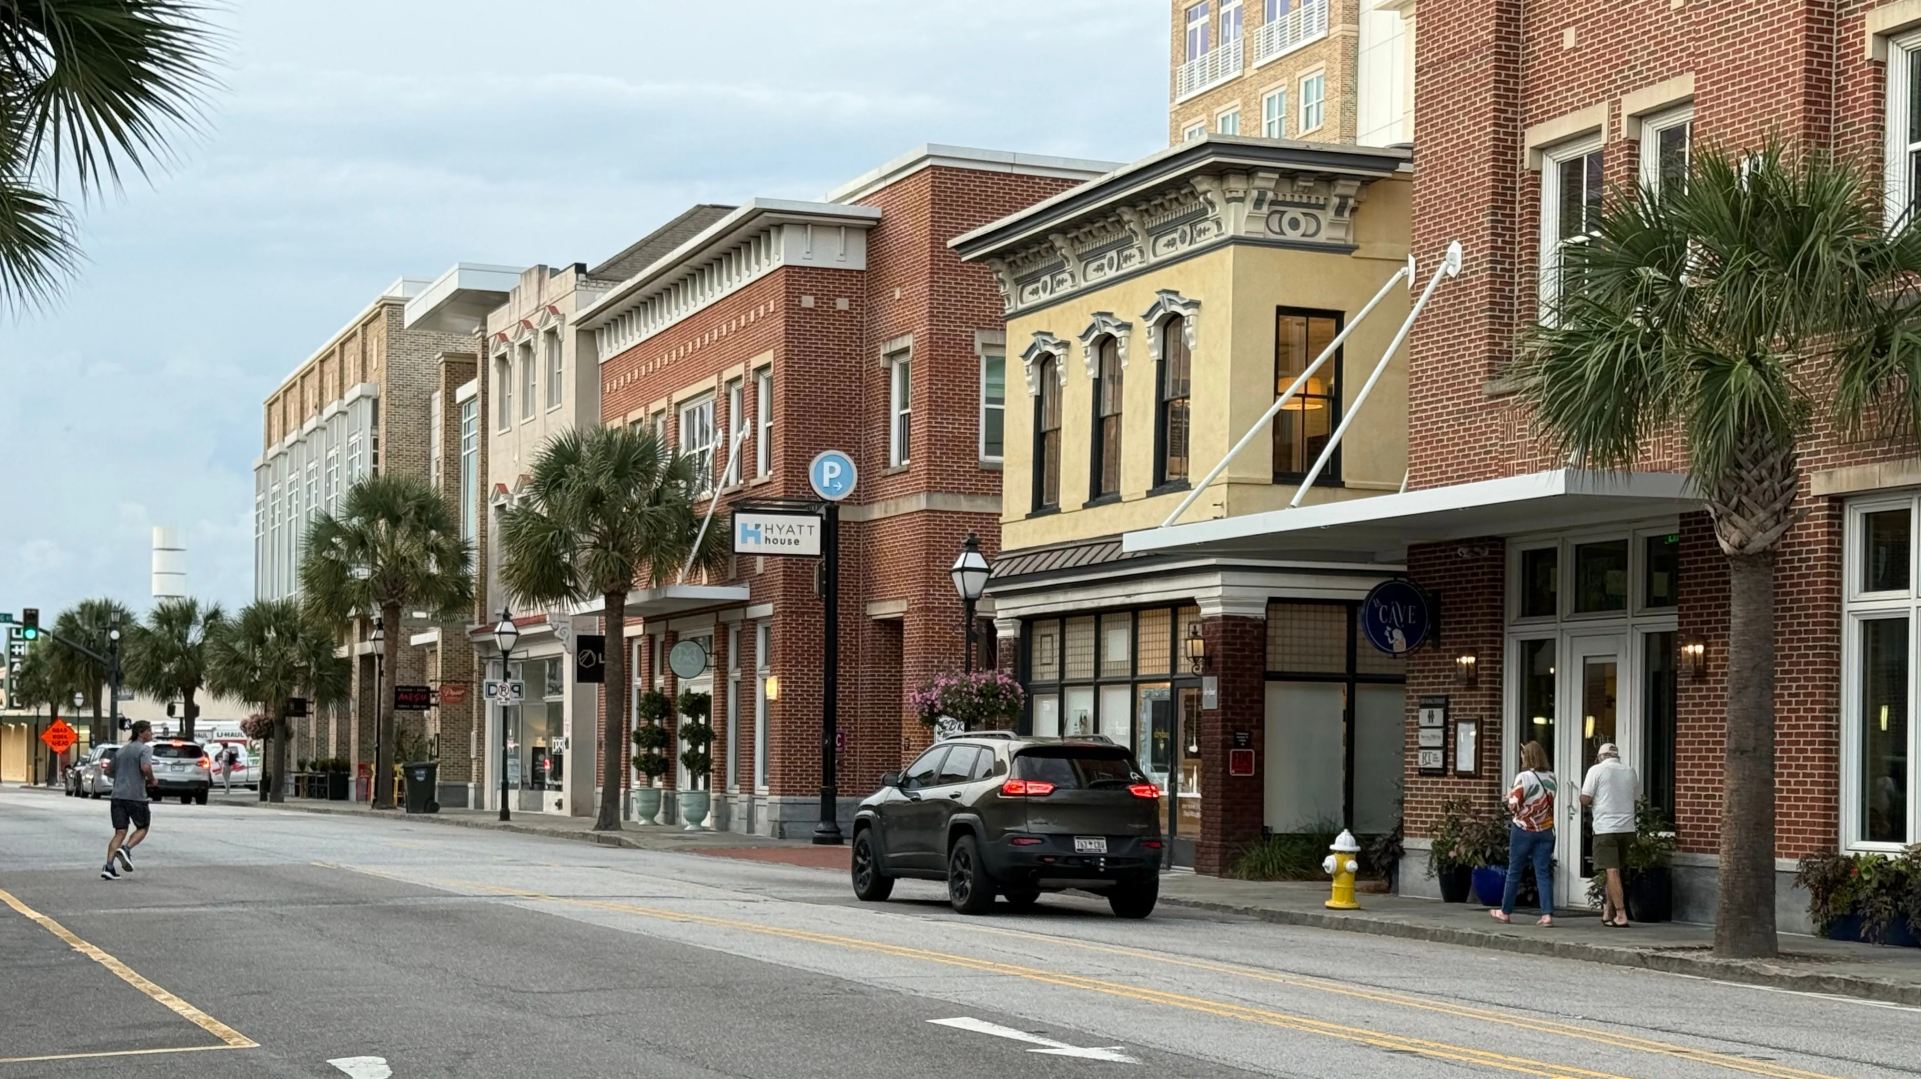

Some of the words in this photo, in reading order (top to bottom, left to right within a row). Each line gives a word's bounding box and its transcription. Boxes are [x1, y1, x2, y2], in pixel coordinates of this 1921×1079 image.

[822, 461, 841, 488] P
[764, 523, 815, 536] HYATT
[764, 535, 800, 546] house
